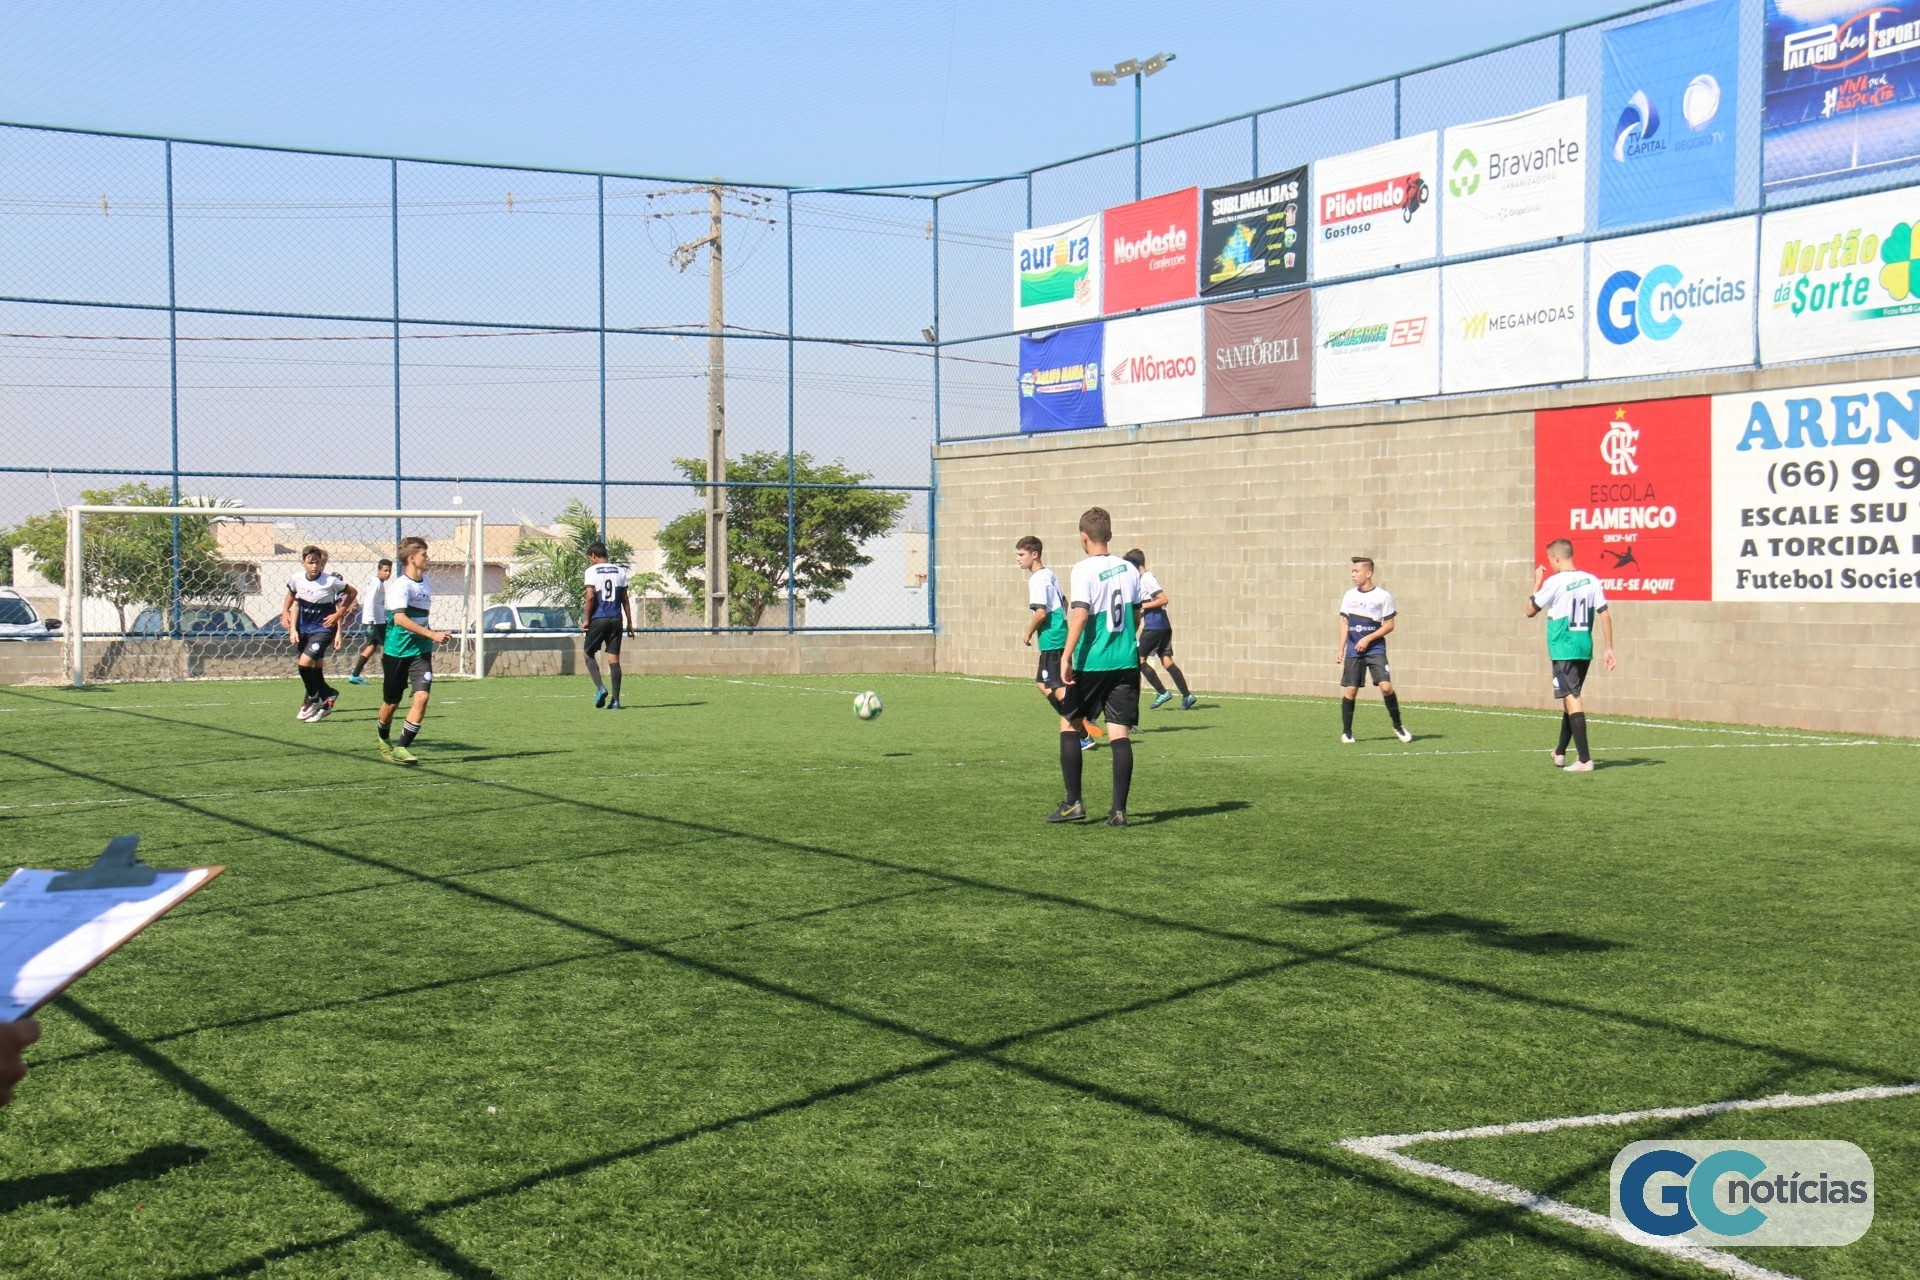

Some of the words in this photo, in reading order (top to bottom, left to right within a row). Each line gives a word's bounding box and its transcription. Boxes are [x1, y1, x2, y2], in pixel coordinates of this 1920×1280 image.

[1627, 139, 1666, 156] CAPITAL
[1629, 132, 1640, 143] TV
[1489, 138, 1579, 180] Bravante
[1212, 181, 1298, 216] SUBLIMALHAS
[1325, 182, 1404, 221] Pilotando
[1325, 221, 1371, 240] Gostoso
[1779, 228, 1878, 277] Nortão
[1774, 281, 1791, 303] dá
[1489, 305, 1575, 331] MEGAMODAS
[1390, 316, 1427, 347] 22
[1216, 337, 1299, 370] SANTORELI
[1131, 354, 1196, 383] Mônaco
[1736, 389, 1920, 451] AREN
[1767, 460, 1839, 494] (66)
[1591, 483, 1655, 503] ESCOLA
[1570, 506, 1676, 530] FLAMENGO
[1741, 505, 1838, 527] ESCALE
[1850, 502, 1907, 523] SEU
[1740, 538, 1758, 557] A
[1768, 535, 1899, 556] TORCIDA
[605, 579, 612, 599] 9
[1642, 578, 1675, 594] AQUI!
[1736, 568, 1833, 589] Futebol
[1111, 589, 1122, 628] 6
[1569, 598, 1588, 627] 11
